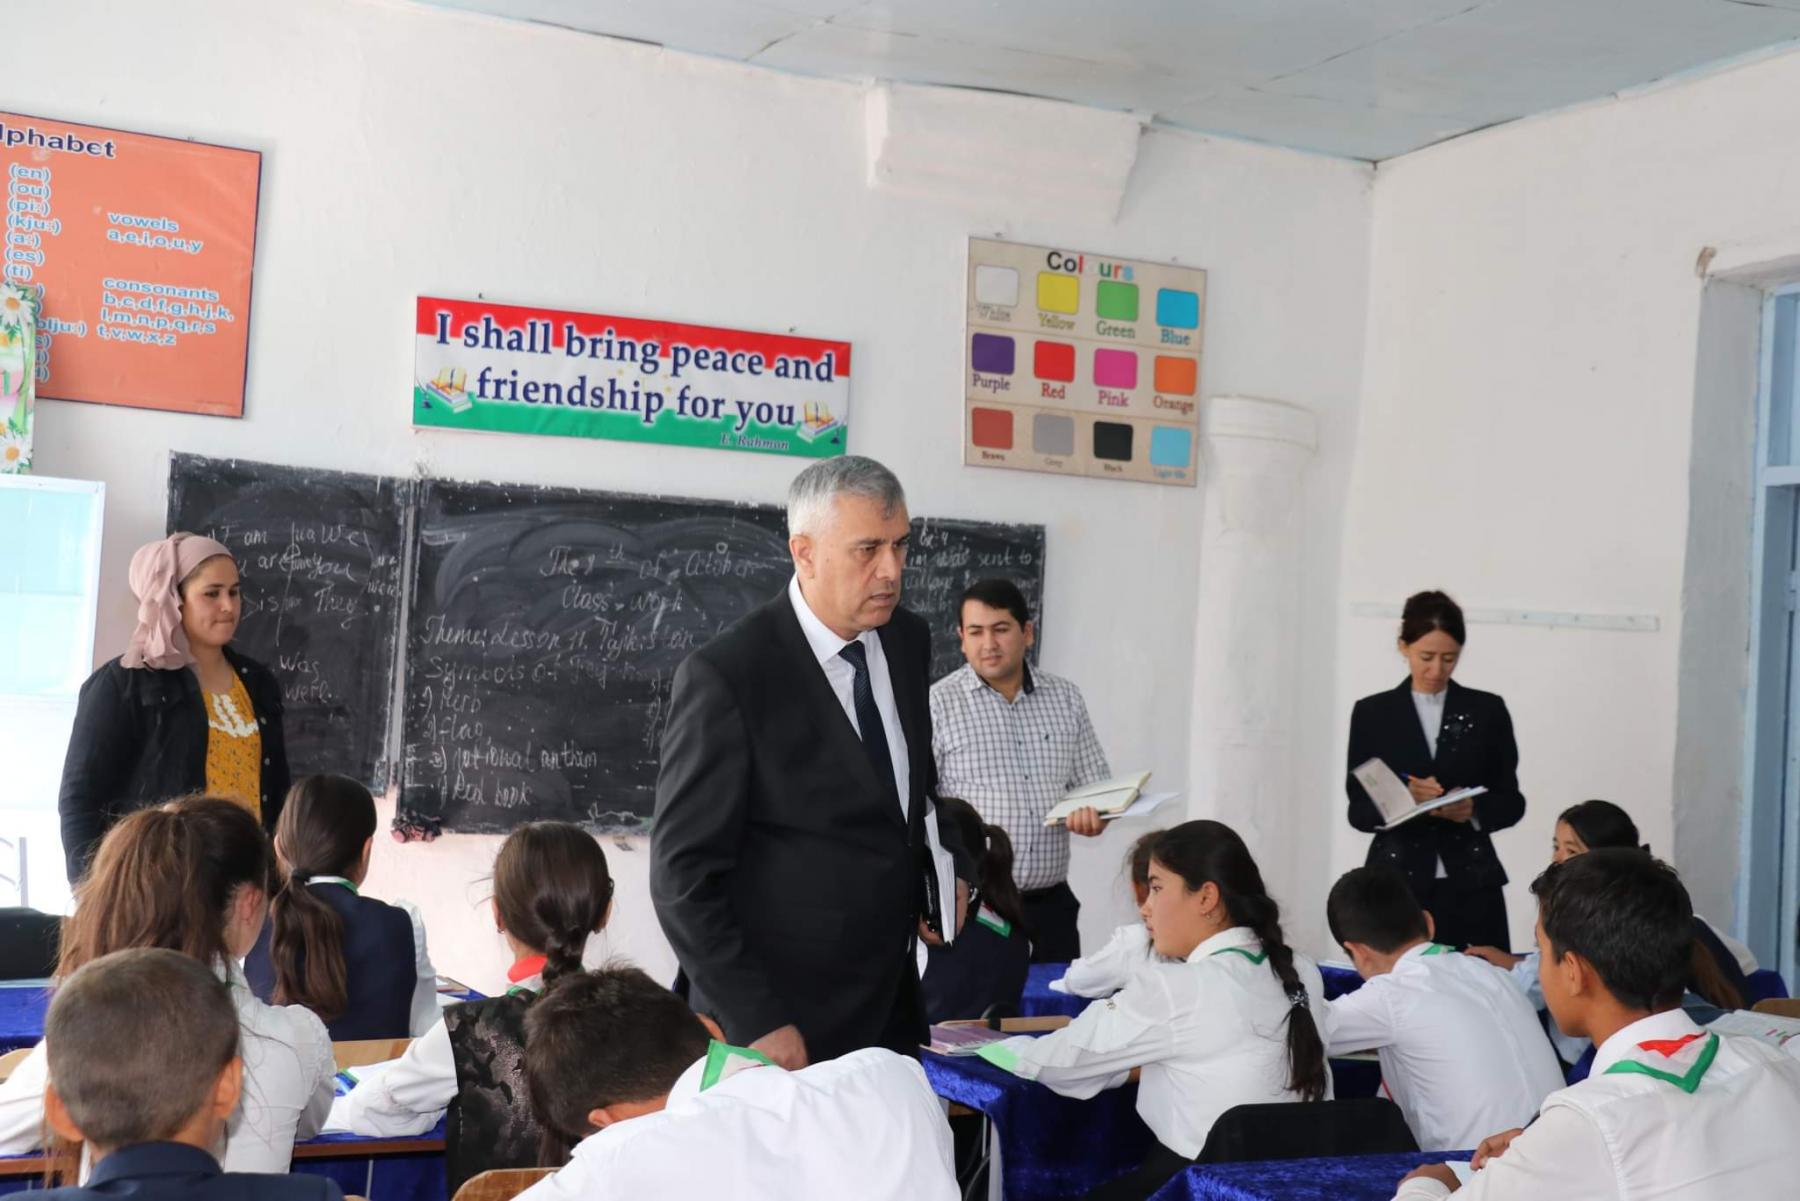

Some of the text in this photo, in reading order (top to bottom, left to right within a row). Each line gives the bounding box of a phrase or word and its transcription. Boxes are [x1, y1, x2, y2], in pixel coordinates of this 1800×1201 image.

[9, 163, 51, 184] (en)
[9, 180, 51, 201] (ou)
[7, 213, 62, 235] (kju:)
[107, 212, 180, 232] vowels
[4, 246, 45, 267] (es)
[103, 277, 220, 302] consonants
[1037, 312, 1077, 331] Yellow
[1096, 320, 1136, 340] Green
[1160, 328, 1192, 346] Blue
[436, 312, 836, 383] I shall bring peace and
[476, 366, 797, 432] friendship for you
[972, 372, 1195, 416] Purple Red Pink Orange
